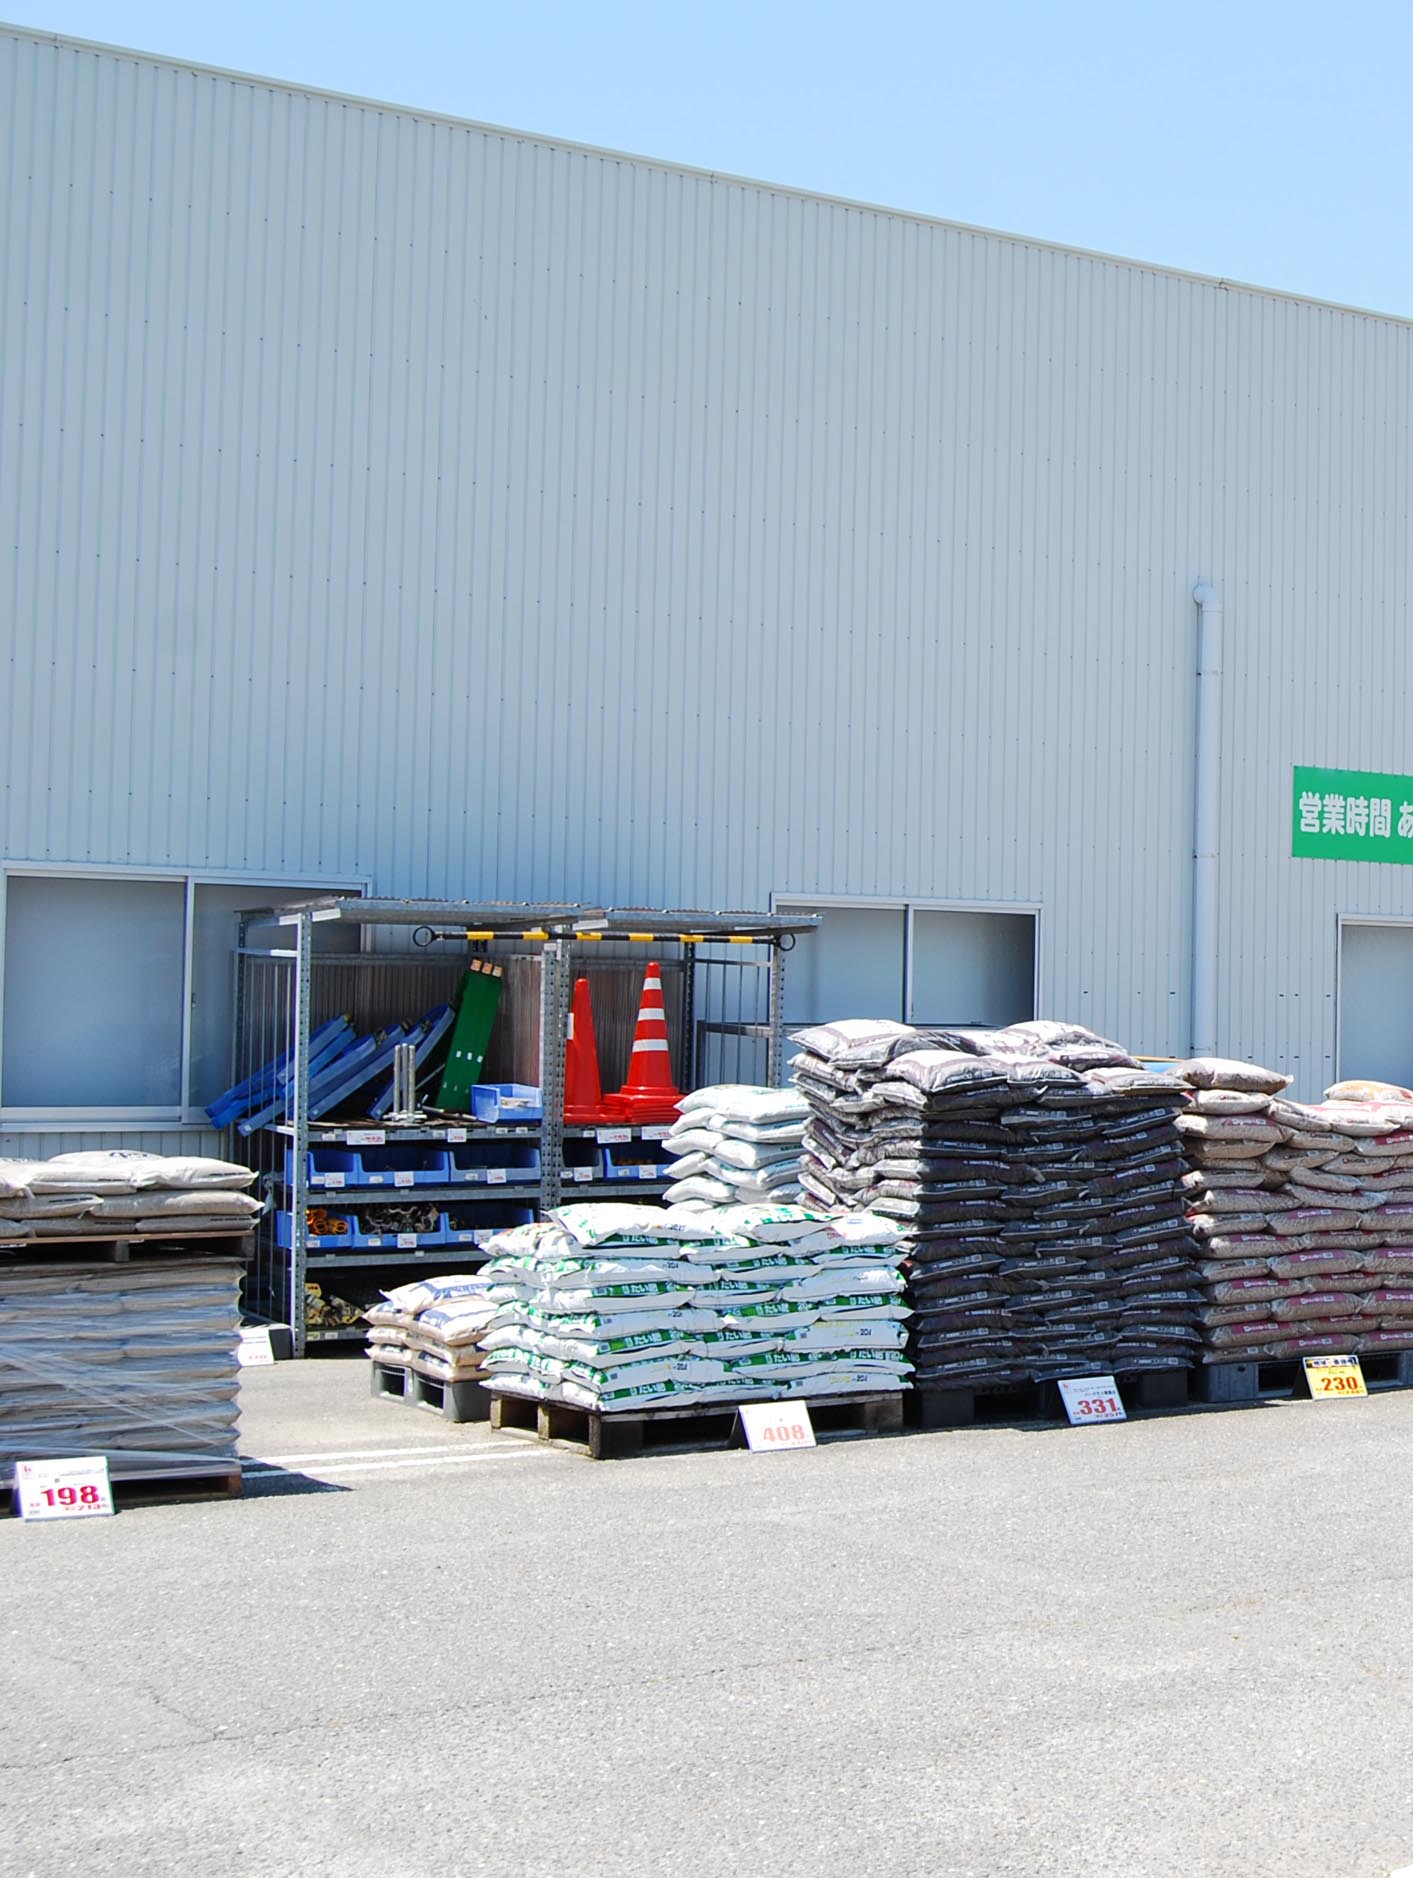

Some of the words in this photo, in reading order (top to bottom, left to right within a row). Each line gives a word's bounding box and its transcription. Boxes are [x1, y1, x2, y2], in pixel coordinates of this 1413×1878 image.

[1321, 1376, 1359, 1391] 230
[1078, 1397, 1117, 1415] 331
[763, 1424, 805, 1442] 408
[40, 1485, 100, 1507] 198
